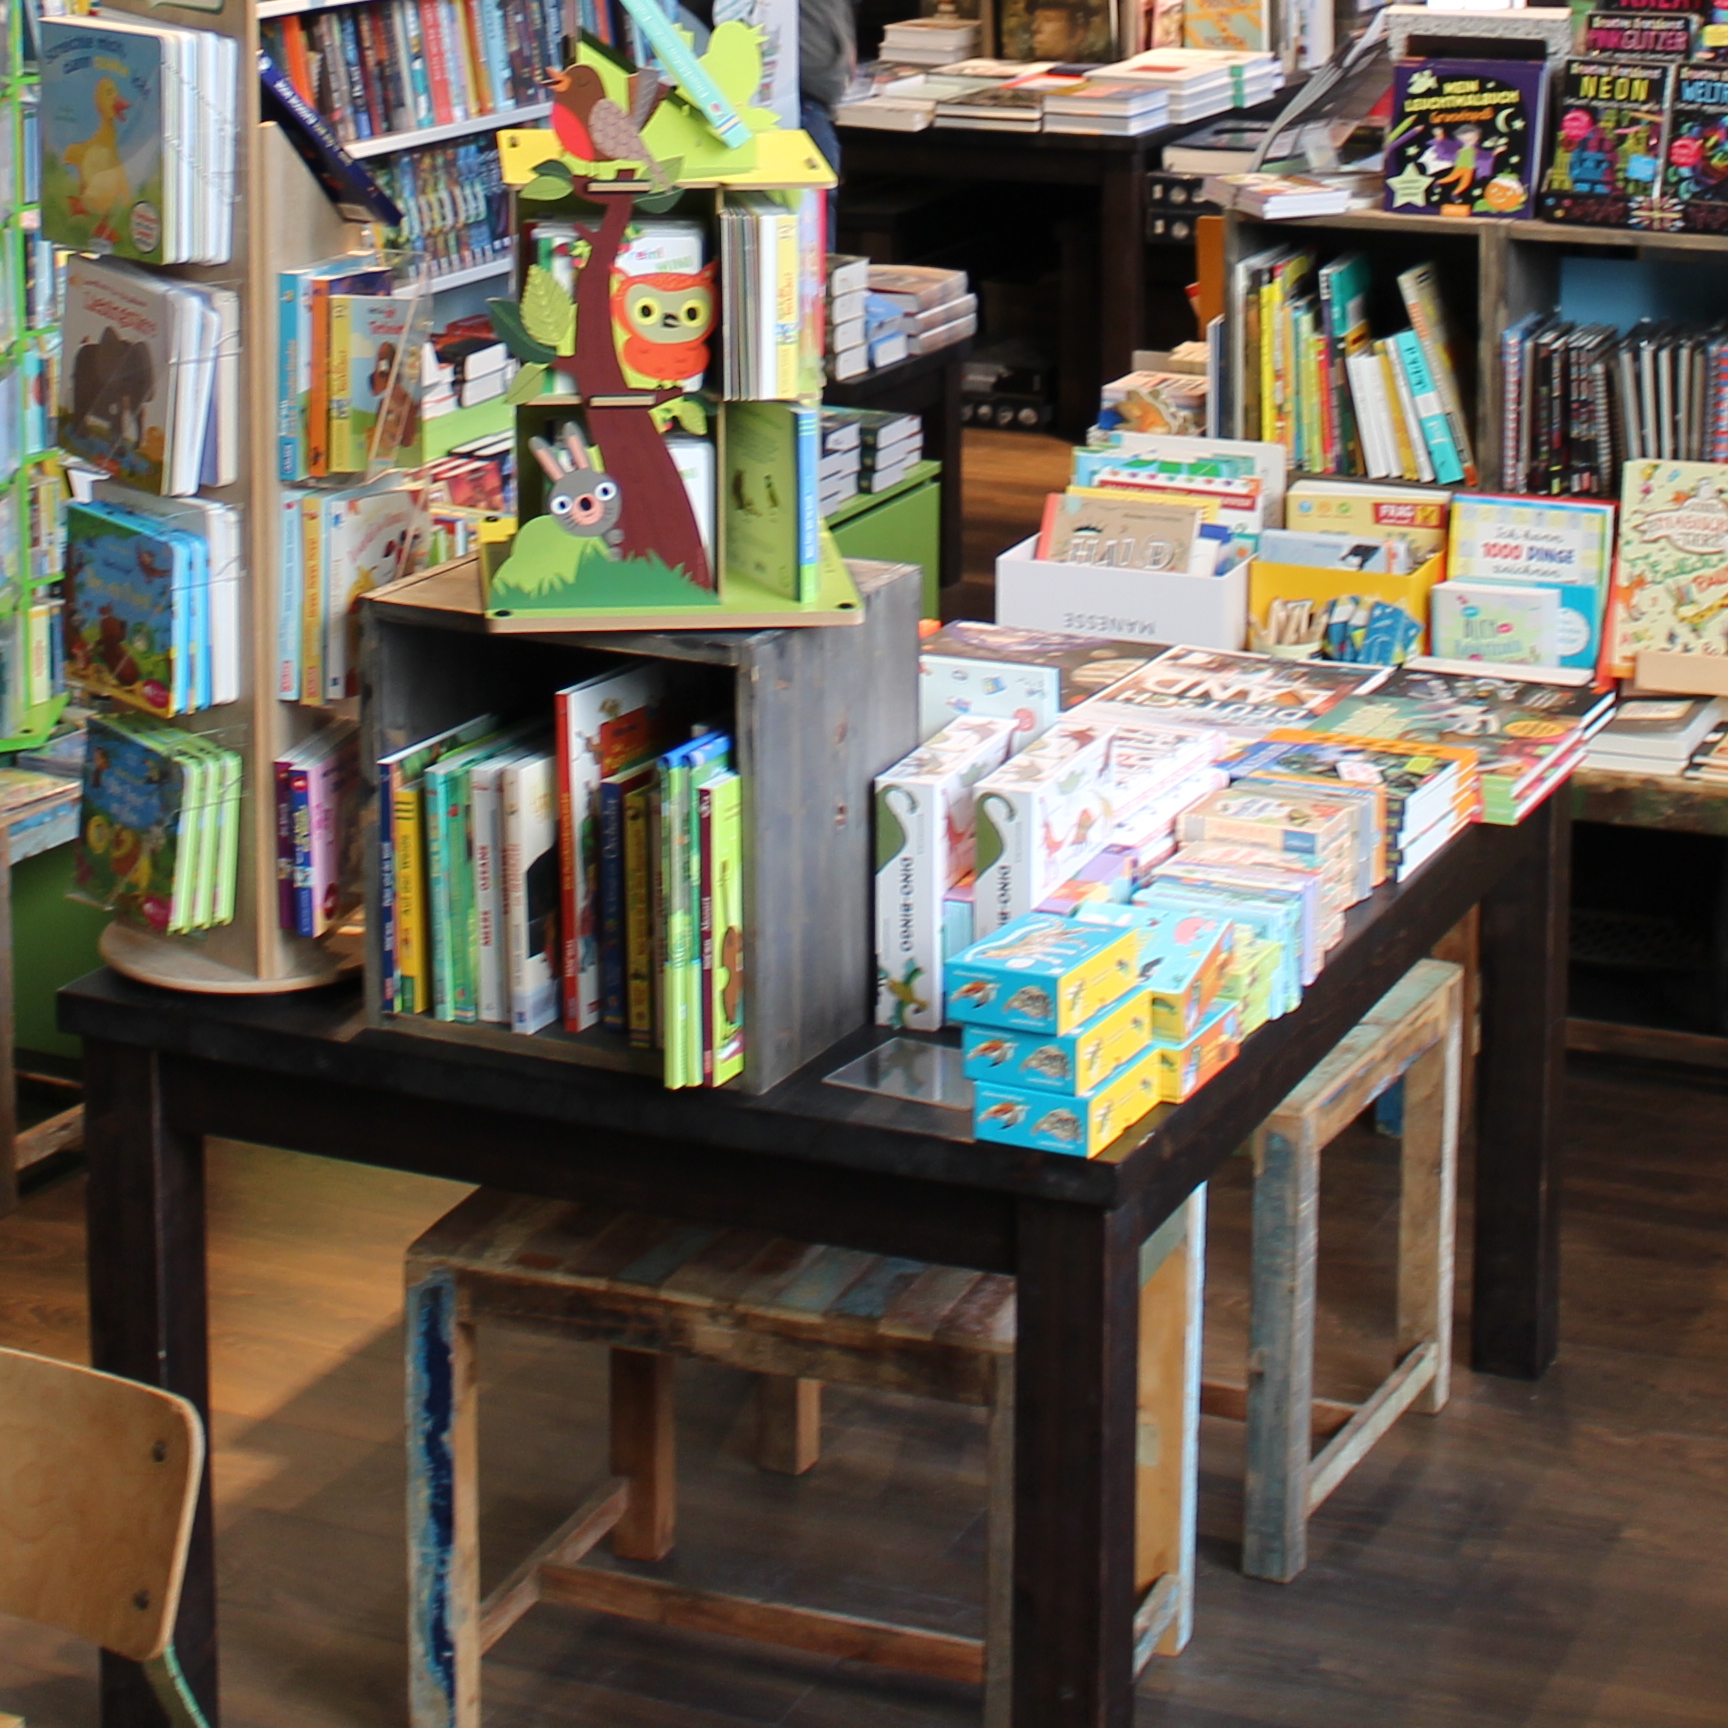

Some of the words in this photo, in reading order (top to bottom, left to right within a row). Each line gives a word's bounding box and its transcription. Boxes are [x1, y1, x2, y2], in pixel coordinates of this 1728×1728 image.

[1579, 75, 1650, 102] NEON
[1482, 541, 1524, 561] 1000
[1525, 546, 1577, 565] DINGE
[1063, 611, 1157, 636] MANESSE
[997, 864, 1011, 925] DINO-B
